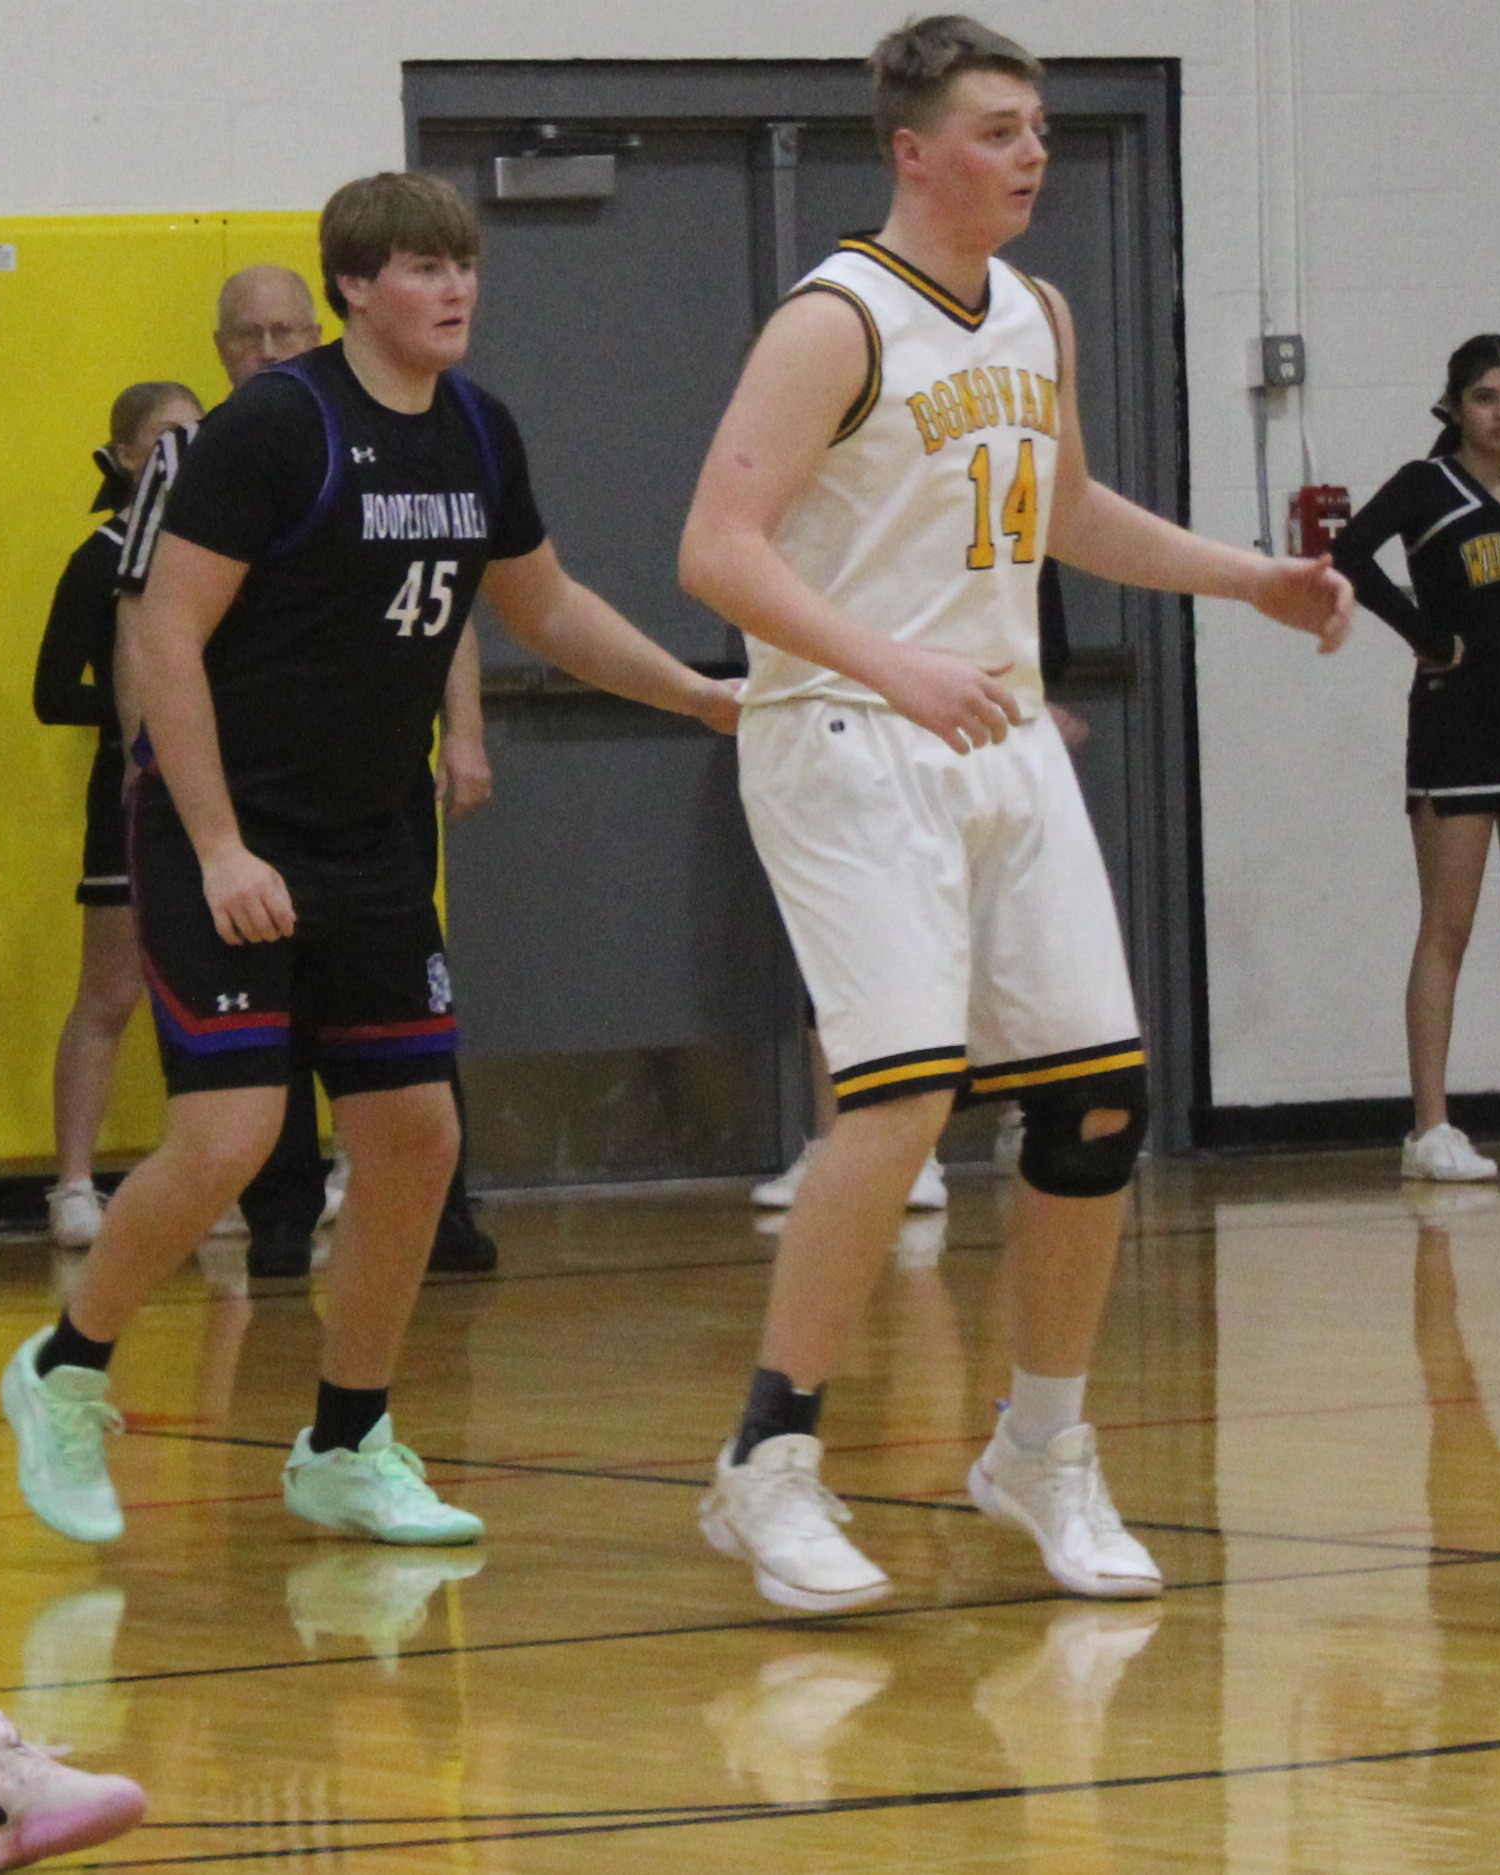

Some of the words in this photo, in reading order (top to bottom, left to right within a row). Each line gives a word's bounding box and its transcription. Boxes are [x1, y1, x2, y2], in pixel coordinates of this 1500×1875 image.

[906, 365, 1060, 456] DONOVAN
[361, 492, 450, 541] HOOPESTON
[449, 492, 489, 540] AREA
[966, 437, 1039, 570] 14
[384, 560, 459, 637] 45
